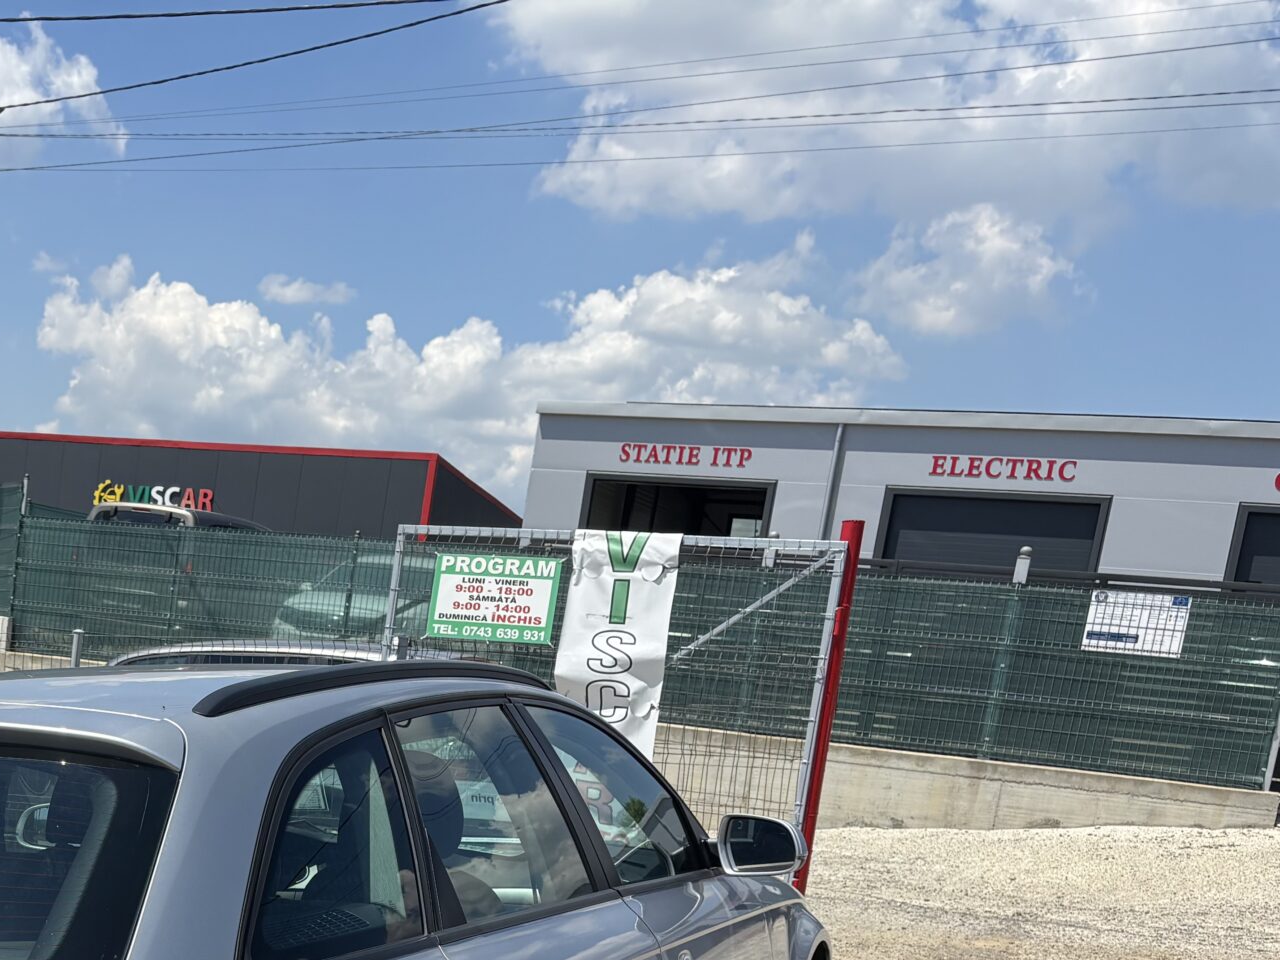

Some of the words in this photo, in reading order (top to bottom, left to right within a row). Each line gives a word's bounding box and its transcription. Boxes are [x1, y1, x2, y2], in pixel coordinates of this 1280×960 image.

[619, 442, 701, 466] STATIE
[710, 447, 753, 468] ITP
[928, 455, 1078, 482] ELECTRIC
[127, 485, 214, 512] VISCAR
[440, 555, 557, 578] PROGRAM
[455, 584, 484, 594] 9:00
[496, 586, 534, 597] 18:00
[462, 577, 486, 585] LUNI
[494, 578, 529, 587] VINERI
[452, 601, 481, 611] 9:00
[493, 604, 531, 614] 14:00
[491, 612, 543, 626] ÎNCHIS
[432, 623, 458, 635] TEL:
[462, 626, 492, 637] 0743
[496, 628, 519, 639] 639
[523, 630, 545, 641] 931
